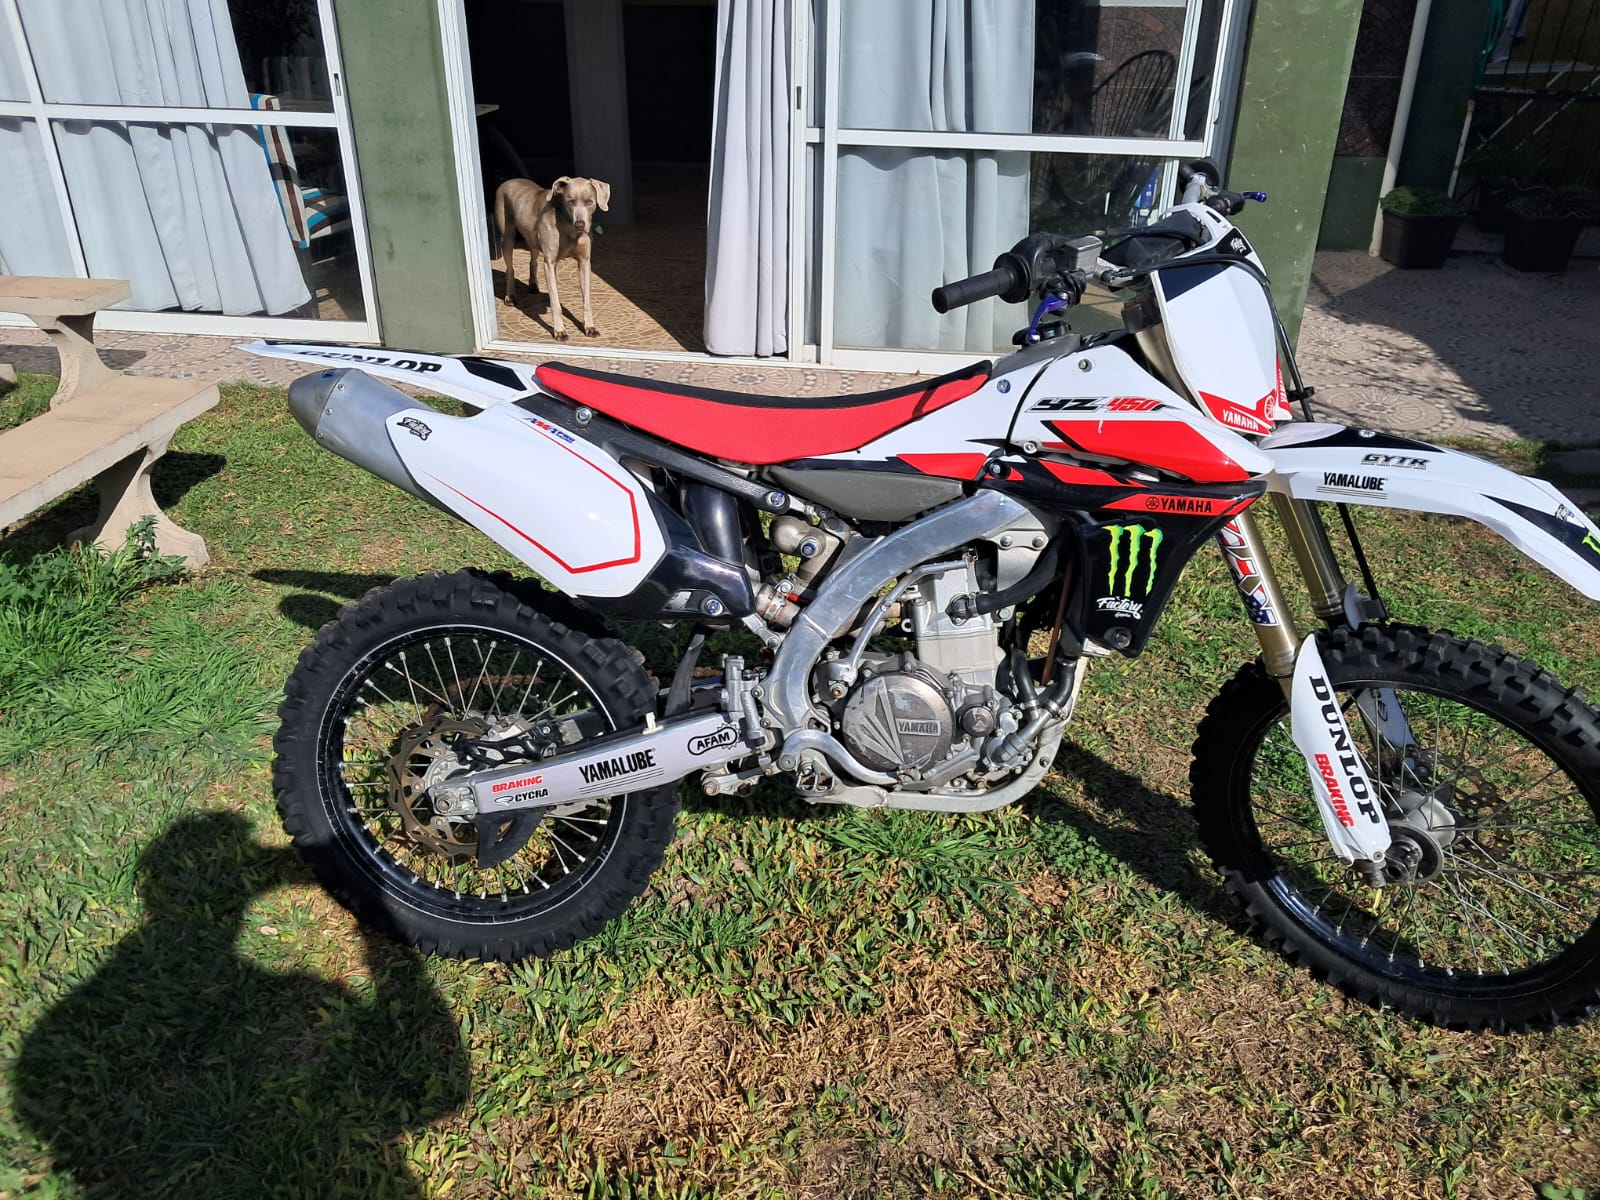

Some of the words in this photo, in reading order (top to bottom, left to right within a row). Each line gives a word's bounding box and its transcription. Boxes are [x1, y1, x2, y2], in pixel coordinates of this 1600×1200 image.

[1222, 409, 1259, 431] YAMAHA
[1362, 453, 1430, 466] GYTR
[1323, 471, 1386, 491] YAMALUBE
[1161, 498, 1212, 513] YAMAHA
[1096, 596, 1143, 620] Factory
[898, 719, 939, 735] YAMAHA
[696, 730, 731, 751] AFAM
[1309, 674, 1380, 825] DUNLOP
[578, 749, 657, 784] YAMALUBE
[491, 775, 544, 793] BRAKING
[1314, 753, 1354, 828] BRAKING
[514, 788, 549, 803] CYCRA
